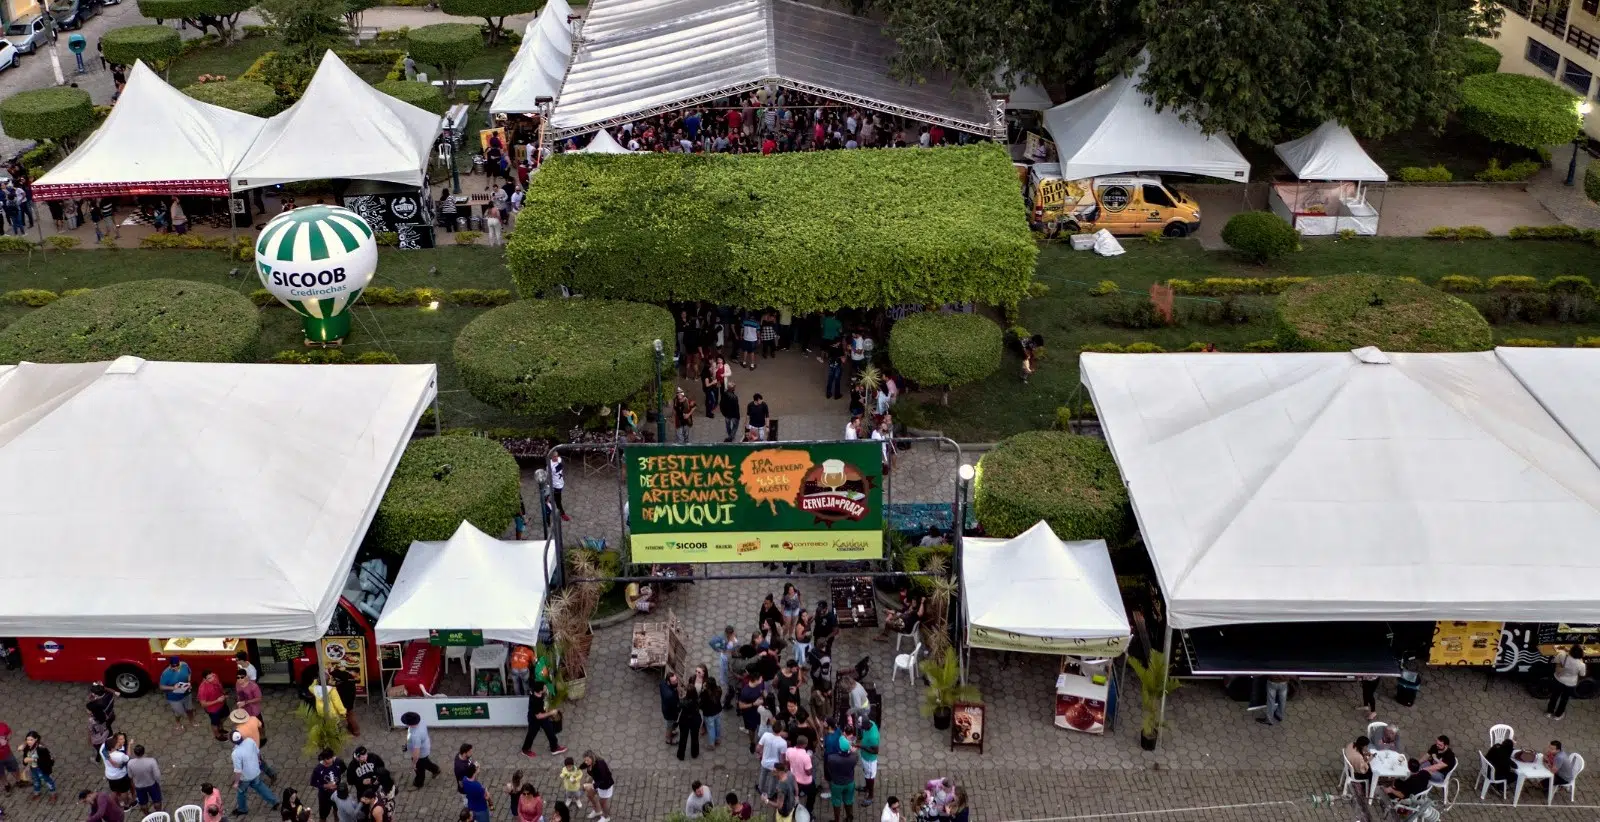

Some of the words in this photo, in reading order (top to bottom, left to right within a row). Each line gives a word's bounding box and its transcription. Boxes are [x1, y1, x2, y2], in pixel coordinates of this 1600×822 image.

[273, 267, 346, 287] SICOOB
[290, 284, 347, 297] Credirochas
[647, 454, 736, 471] FESTIVAL
[751, 458, 773, 468] IPA
[769, 463, 804, 474] WEEKEND
[640, 475, 652, 488] DE
[649, 470, 735, 488] CERVEJAS
[642, 487, 739, 503] ARTESANAIS
[758, 484, 790, 494] AGOSTO
[642, 507, 654, 521] DE
[653, 503, 736, 526] MUQUI
[802, 496, 836, 510] CERVEJA
[840, 499, 865, 517] PRAÇA
[676, 542, 708, 550] SICOOB
[408, 648, 428, 675] ITAIPAVA
